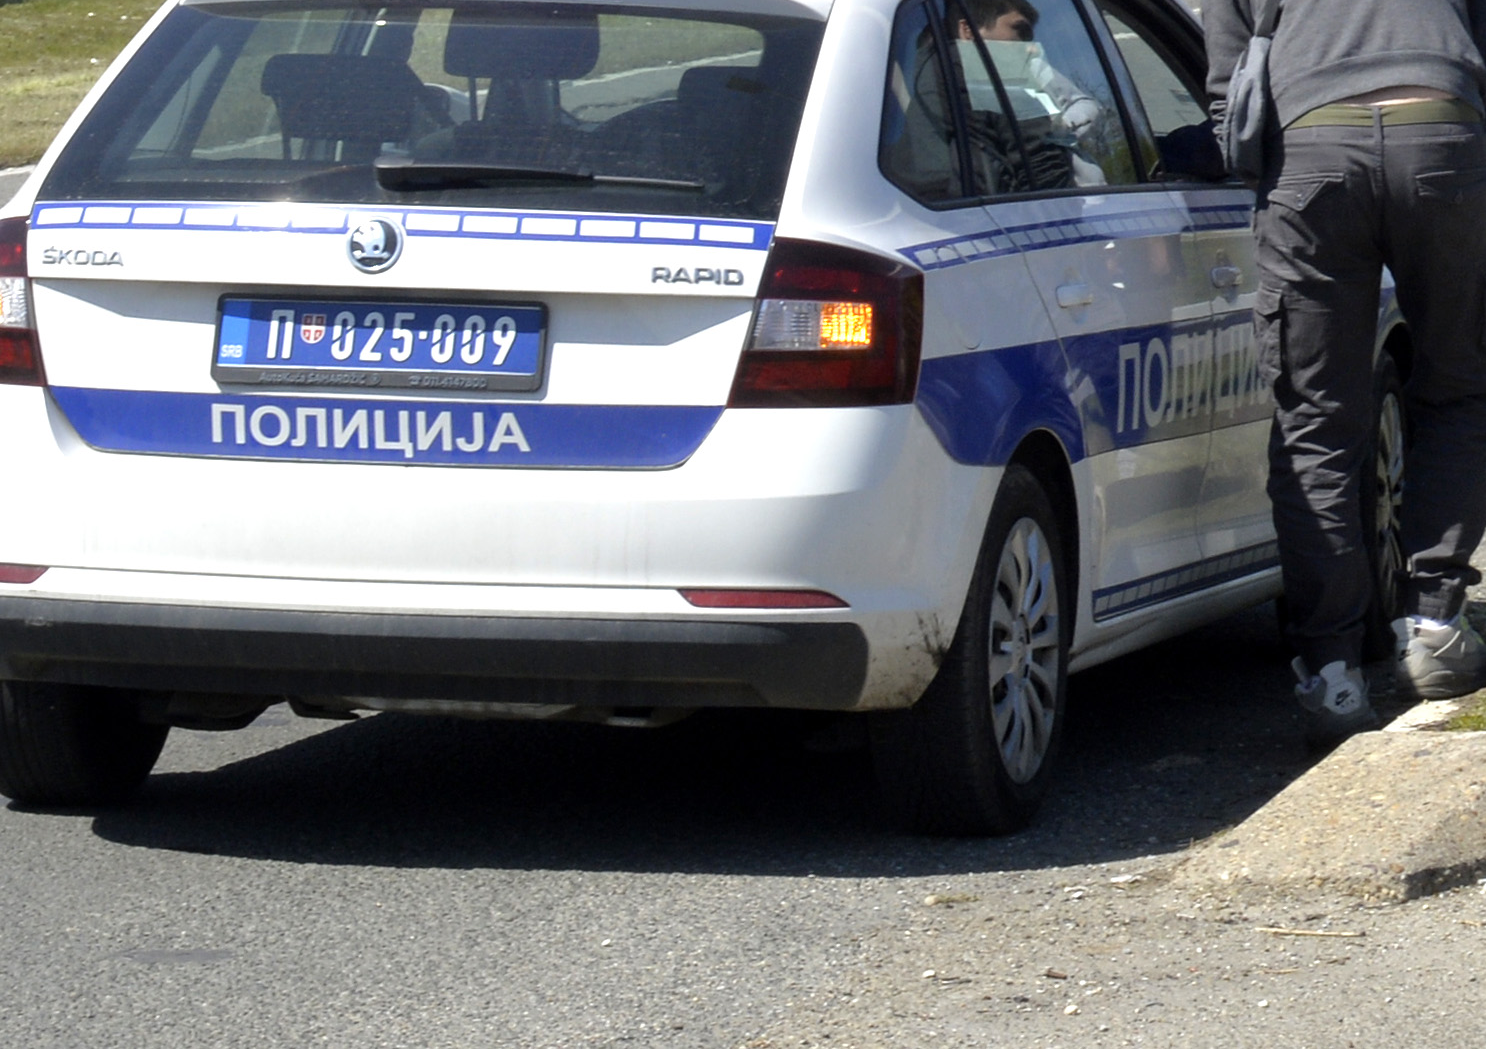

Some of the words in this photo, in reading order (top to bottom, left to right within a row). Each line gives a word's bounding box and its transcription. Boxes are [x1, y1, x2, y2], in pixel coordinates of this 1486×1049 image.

[651, 267, 744, 286] RAPID
[220, 344, 243, 358] SRB
[211, 403, 531, 458] ПОЛИЦИЈА
